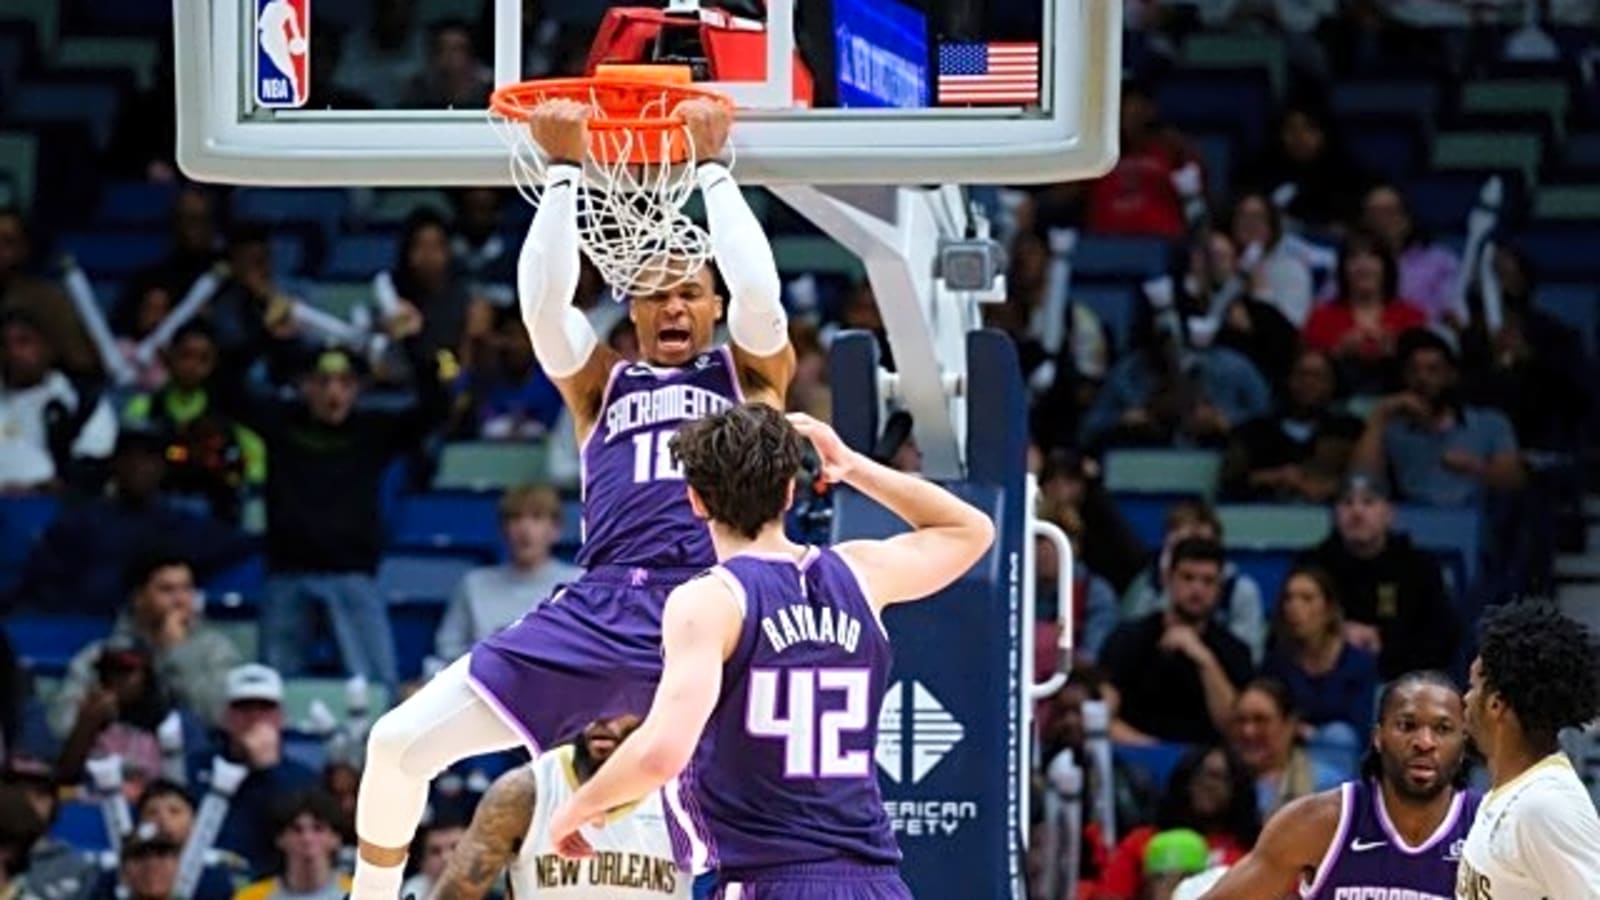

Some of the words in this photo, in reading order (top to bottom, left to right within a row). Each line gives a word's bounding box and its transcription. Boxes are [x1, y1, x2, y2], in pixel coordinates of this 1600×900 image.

[262, 78, 289, 99] NBA
[604, 384, 734, 443] SACRAMENT
[761, 604, 861, 653] RAYNAUD
[745, 667, 871, 778] 42
[883, 801, 977, 818] ERICAN
[890, 819, 958, 835] FETY
[535, 853, 581, 888] NEW
[589, 850, 676, 894] ORLEANS
